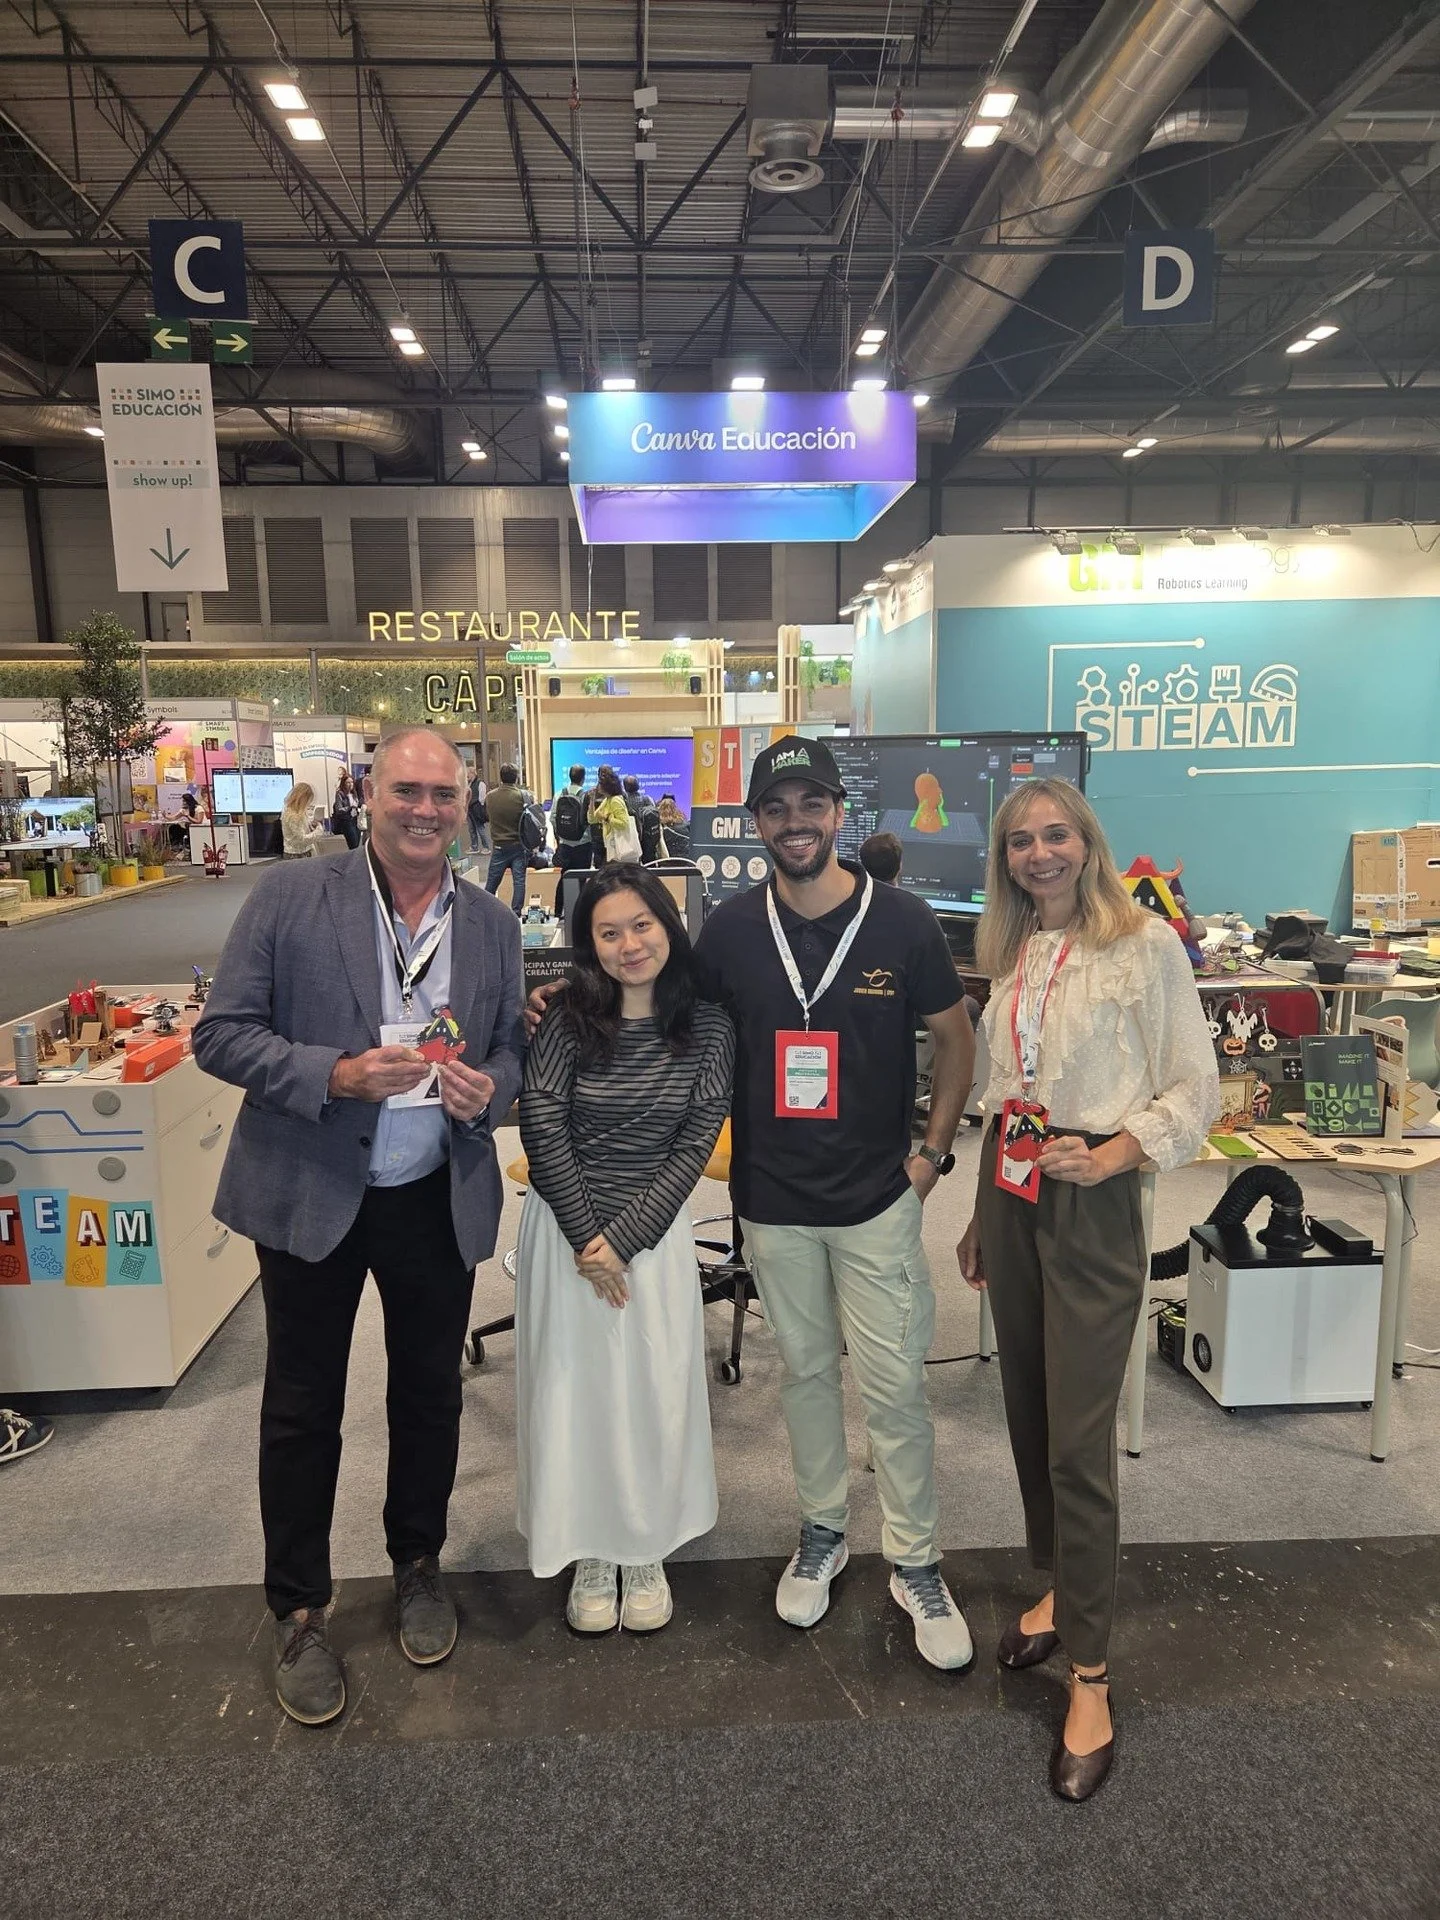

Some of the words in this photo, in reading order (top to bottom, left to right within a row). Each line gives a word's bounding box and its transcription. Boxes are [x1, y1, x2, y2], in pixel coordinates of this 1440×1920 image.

[173, 235, 226, 304] C
[1142, 245, 1195, 311] D
[136, 388, 176, 401] SIMO
[111, 402, 203, 417] EDUCACIÓN
[630, 422, 716, 453] Canva
[721, 426, 857, 451] Educación
[132, 472, 168, 487] show
[171, 474, 193, 489] up!
[1157, 577, 1203, 591] Robotics
[1205, 578, 1249, 592] Learning
[368, 610, 642, 642] RESTAURANTE
[147, 705, 178, 715] Symbols
[1079, 705, 1297, 750] STEAM
[711, 816, 741, 839] GM
[525, 968, 565, 976] CREALITY!
